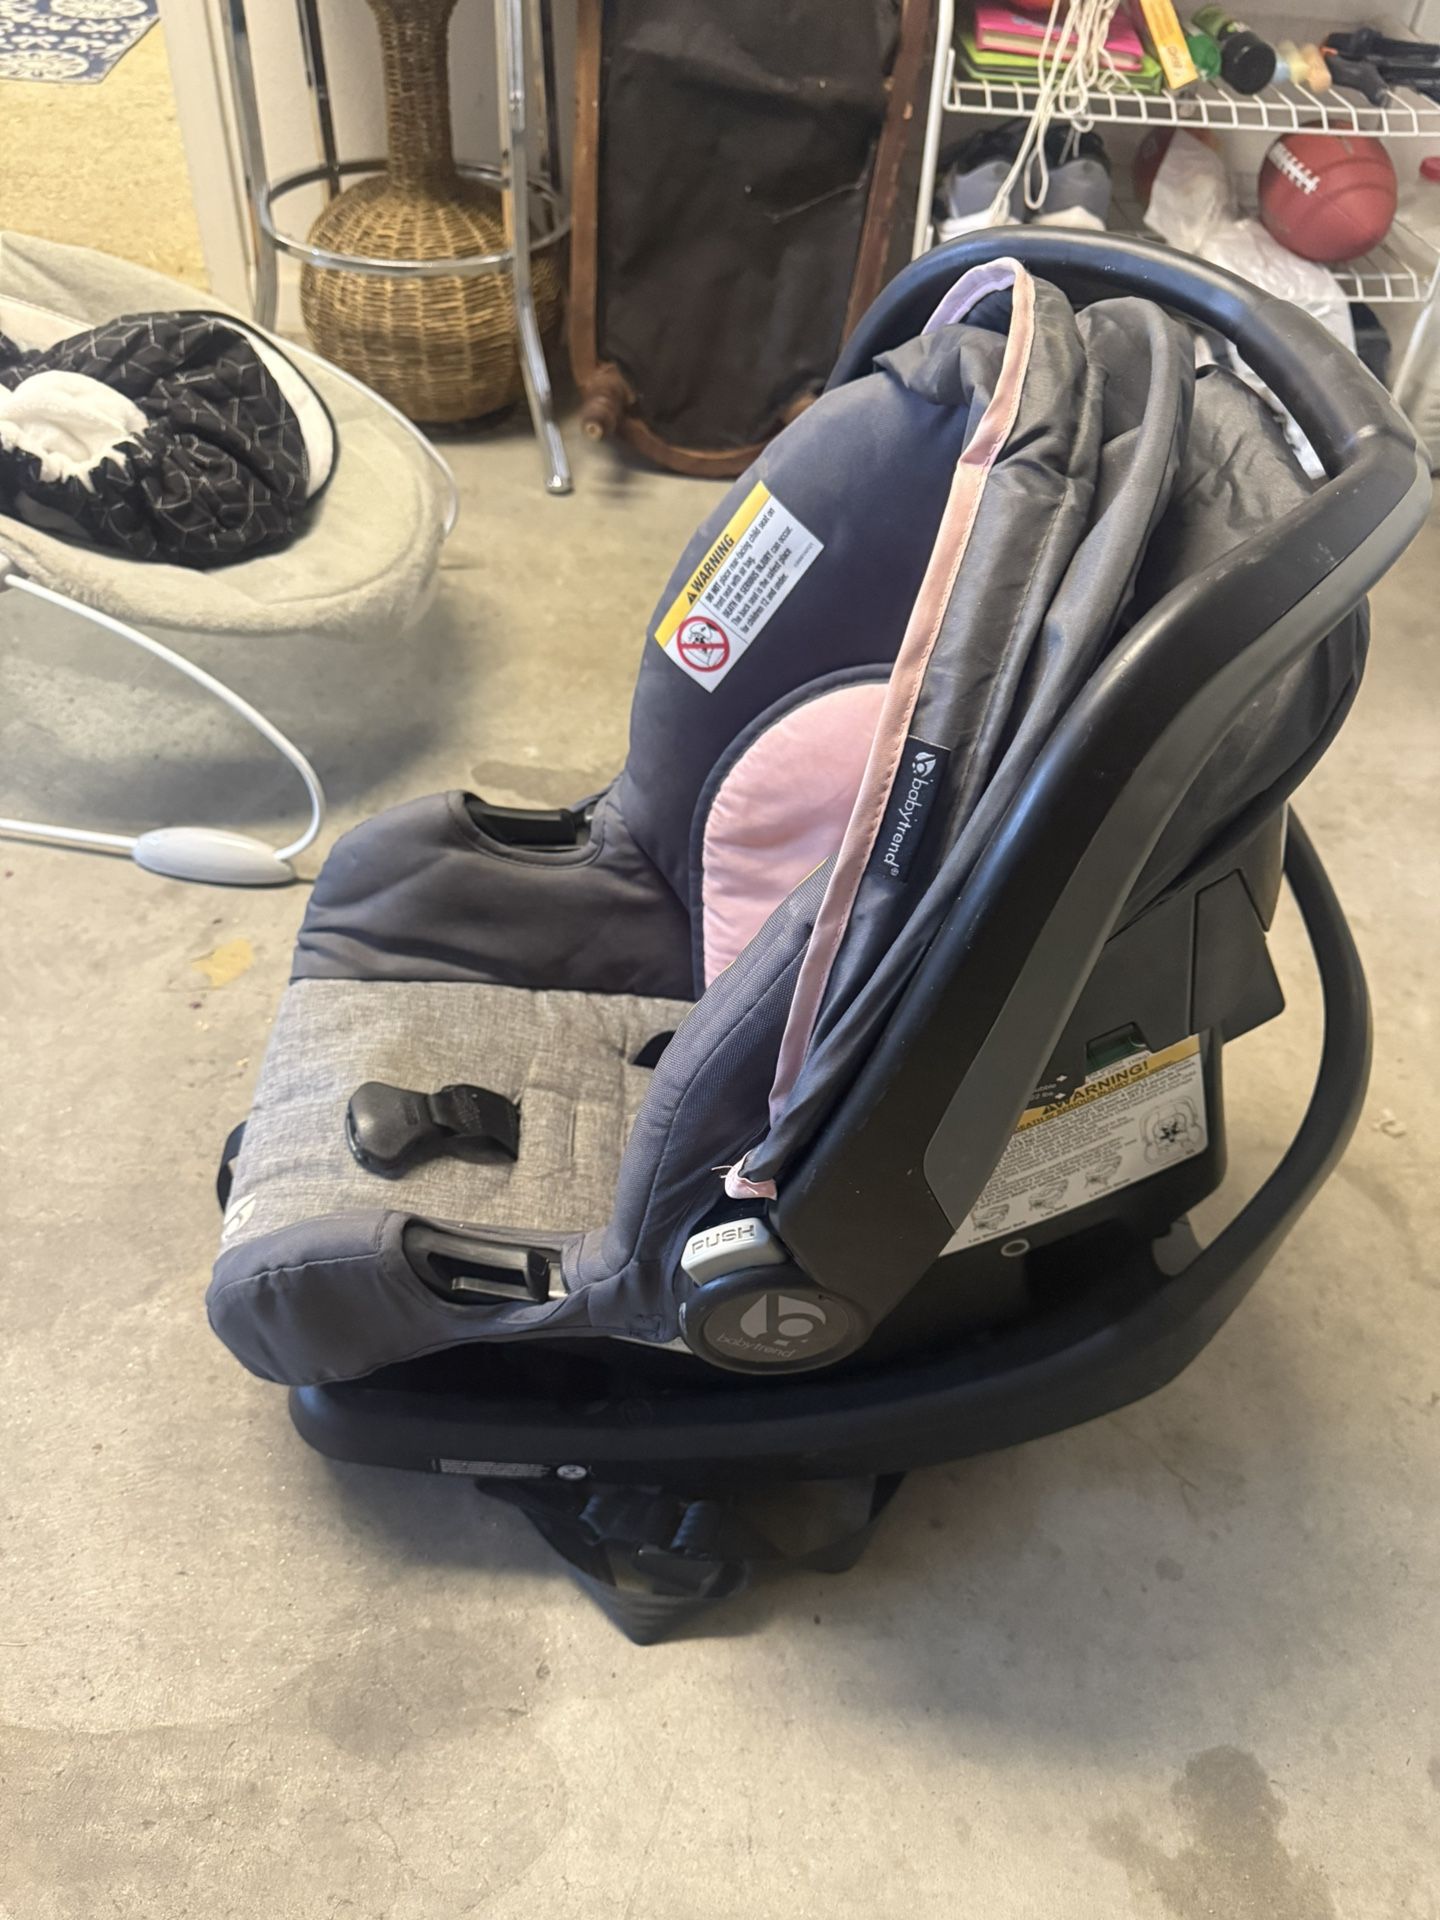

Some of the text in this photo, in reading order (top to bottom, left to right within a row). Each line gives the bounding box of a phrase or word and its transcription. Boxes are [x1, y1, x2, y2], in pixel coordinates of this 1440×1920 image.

[692, 534, 735, 593] WARNING
[705, 508, 775, 603] DO NOT place rear-facing child seat on
[713, 595, 726, 610] front
[723, 585, 734, 599] seat
[731, 574, 741, 587] with
[739, 566, 747, 576] air
[723, 600, 738, 618] DEATH
[734, 592, 743, 602] OR
[740, 570, 759, 595] SERIOUS
[755, 551, 773, 573] INJURY
[770, 542, 781, 554] can
[731, 615, 742, 626] The
[738, 603, 751, 618] back
[748, 591, 759, 606] seat
[759, 578, 769, 589] the
[767, 561, 782, 580] safest
[778, 548, 792, 565] place
[740, 625, 750, 633] for
[747, 606, 764, 626] children
[760, 598, 770, 607] 12
[766, 588, 777, 601] and
[1056, 1061, 1148, 1109] WARNING!
[1056, 1092, 1097, 1116] SERIOUS
[692, 1224, 755, 1254] PUSH
[716, 1331, 798, 1359] babytrend
